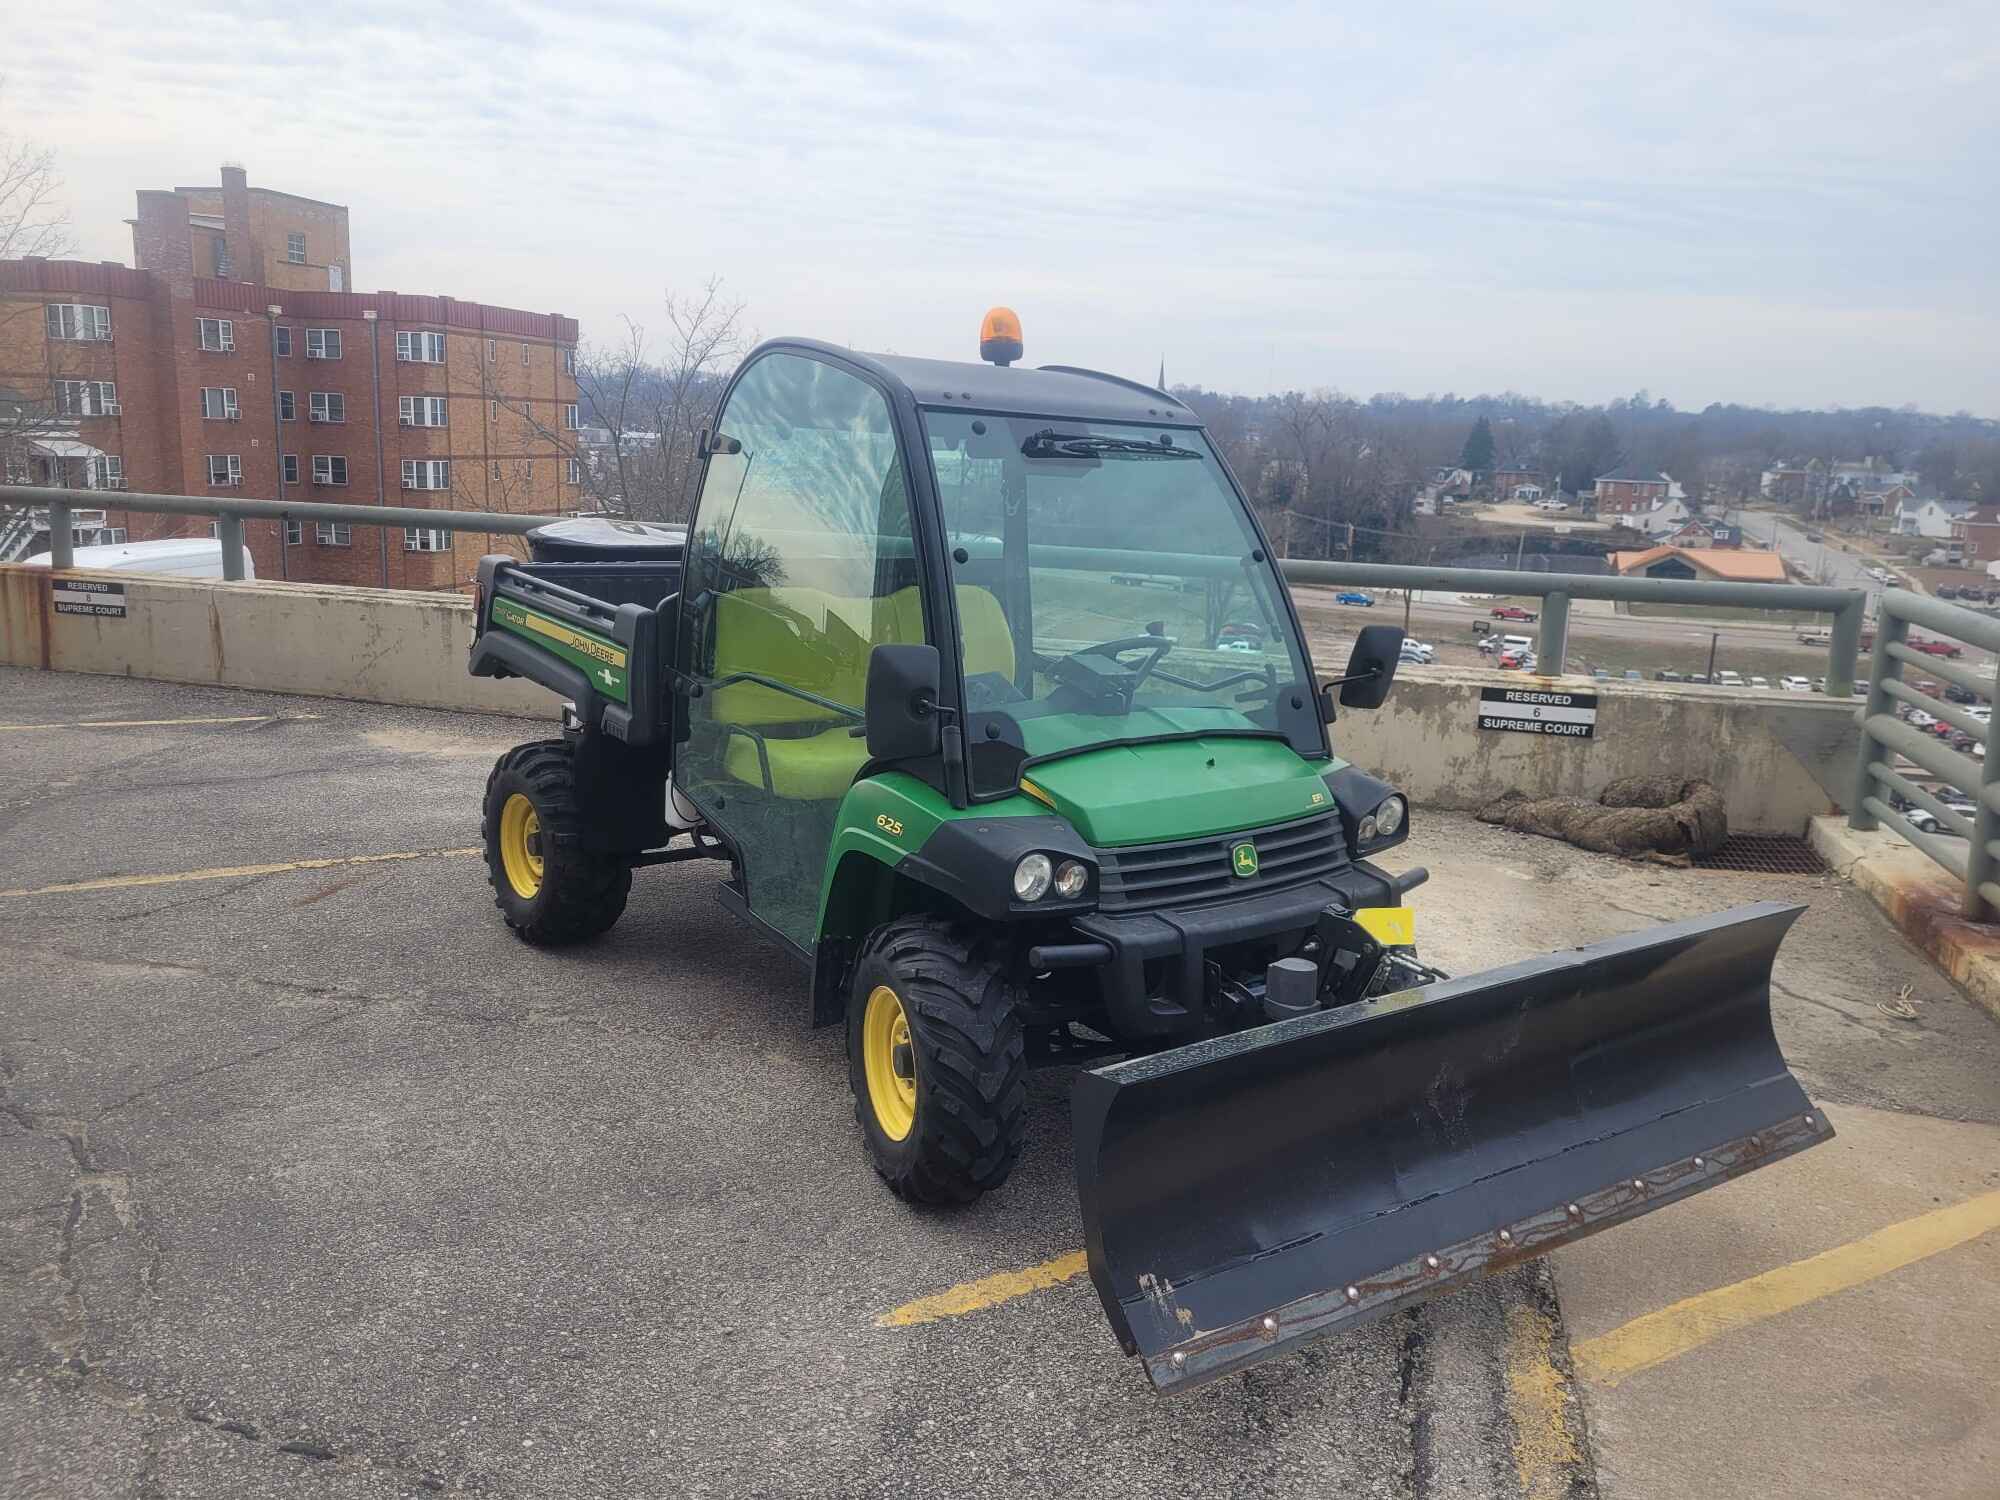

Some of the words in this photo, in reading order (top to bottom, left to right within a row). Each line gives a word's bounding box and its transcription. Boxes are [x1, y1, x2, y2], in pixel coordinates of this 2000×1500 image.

[67, 582, 108, 592] RESERVED
[57, 603, 94, 613] SUPREME
[95, 607, 121, 615] COURT
[570, 633, 590, 655] JOHN
[591, 642, 615, 664] DEERE
[1506, 691, 1572, 705] RESERVED
[1533, 707, 1541, 718] 6
[1483, 718, 1542, 732] SUPREME
[1545, 723, 1589, 736] COURT
